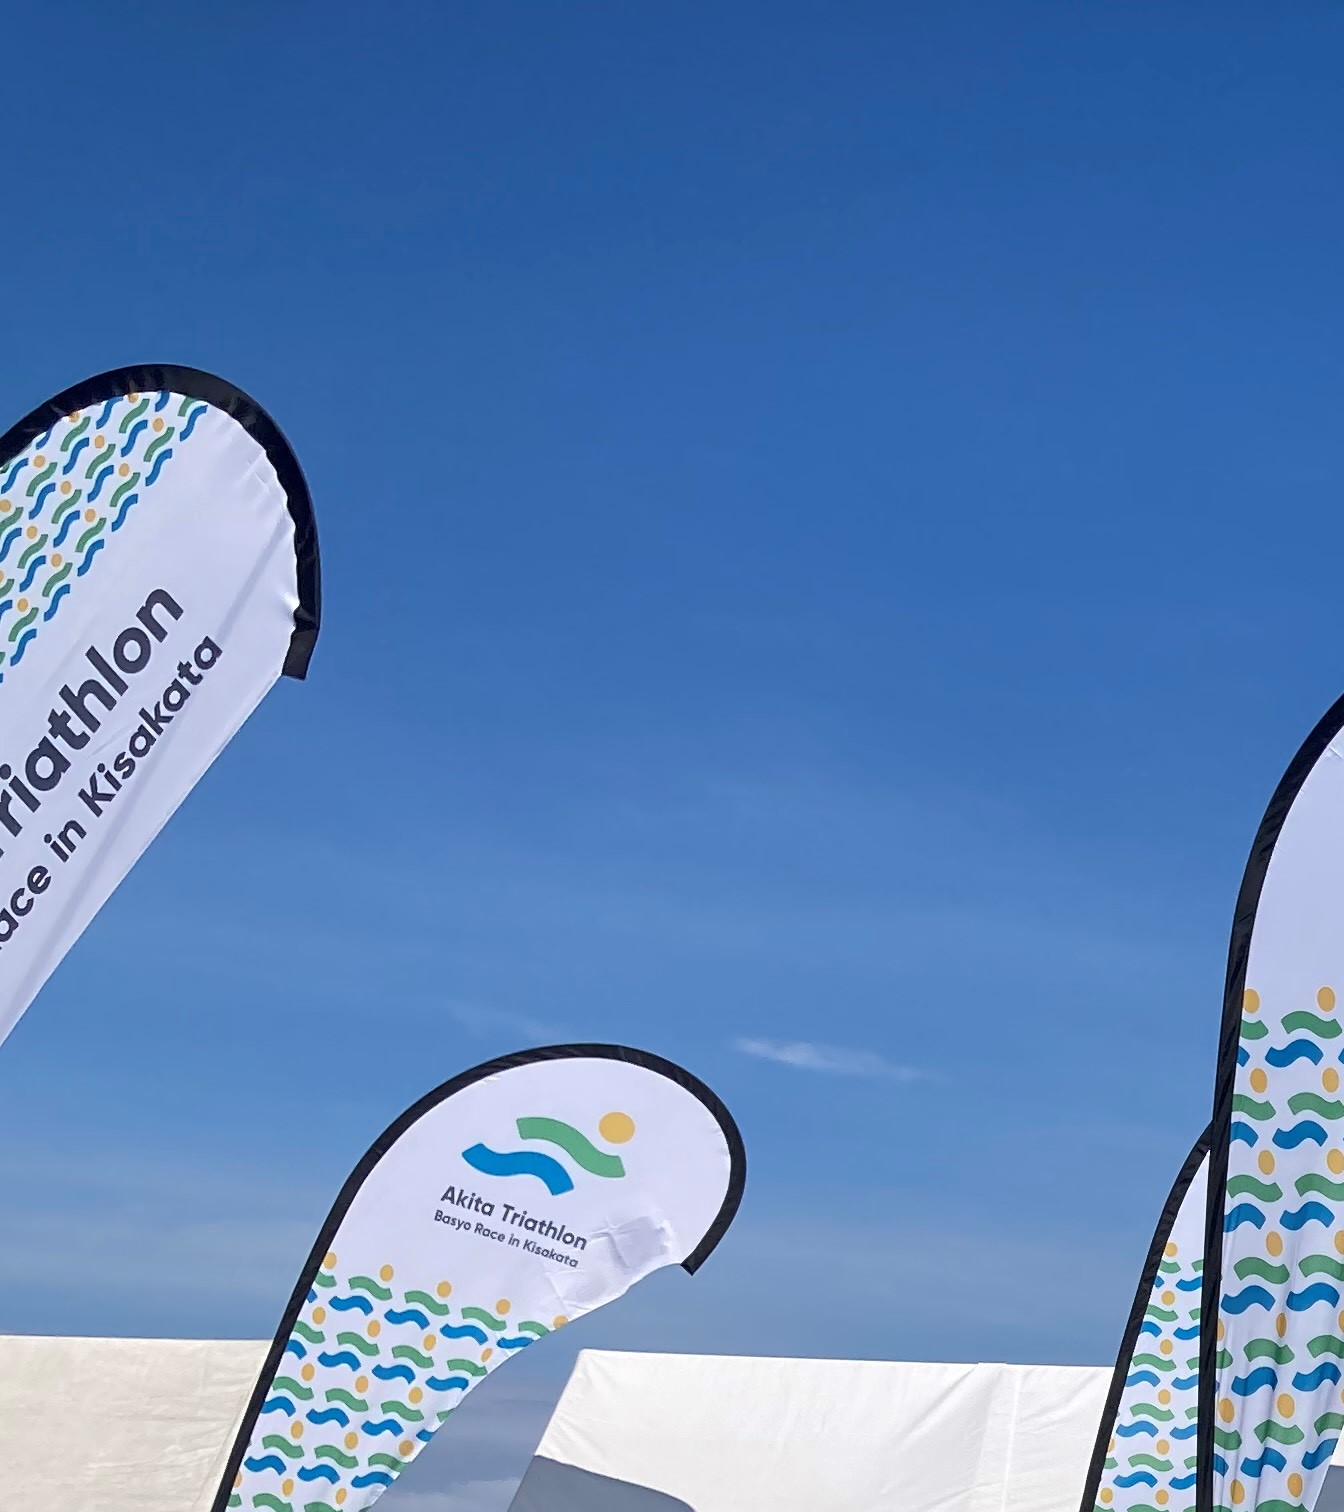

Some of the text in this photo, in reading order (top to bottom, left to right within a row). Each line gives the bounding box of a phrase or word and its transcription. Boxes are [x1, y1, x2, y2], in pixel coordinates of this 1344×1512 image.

[0, 588, 184, 858] riathlon
[0, 636, 223, 950] ace in Kisakata
[434, 1209, 579, 1268] Basyo Race in Kisakata
[440, 1185, 588, 1251] Akita Triathlon
